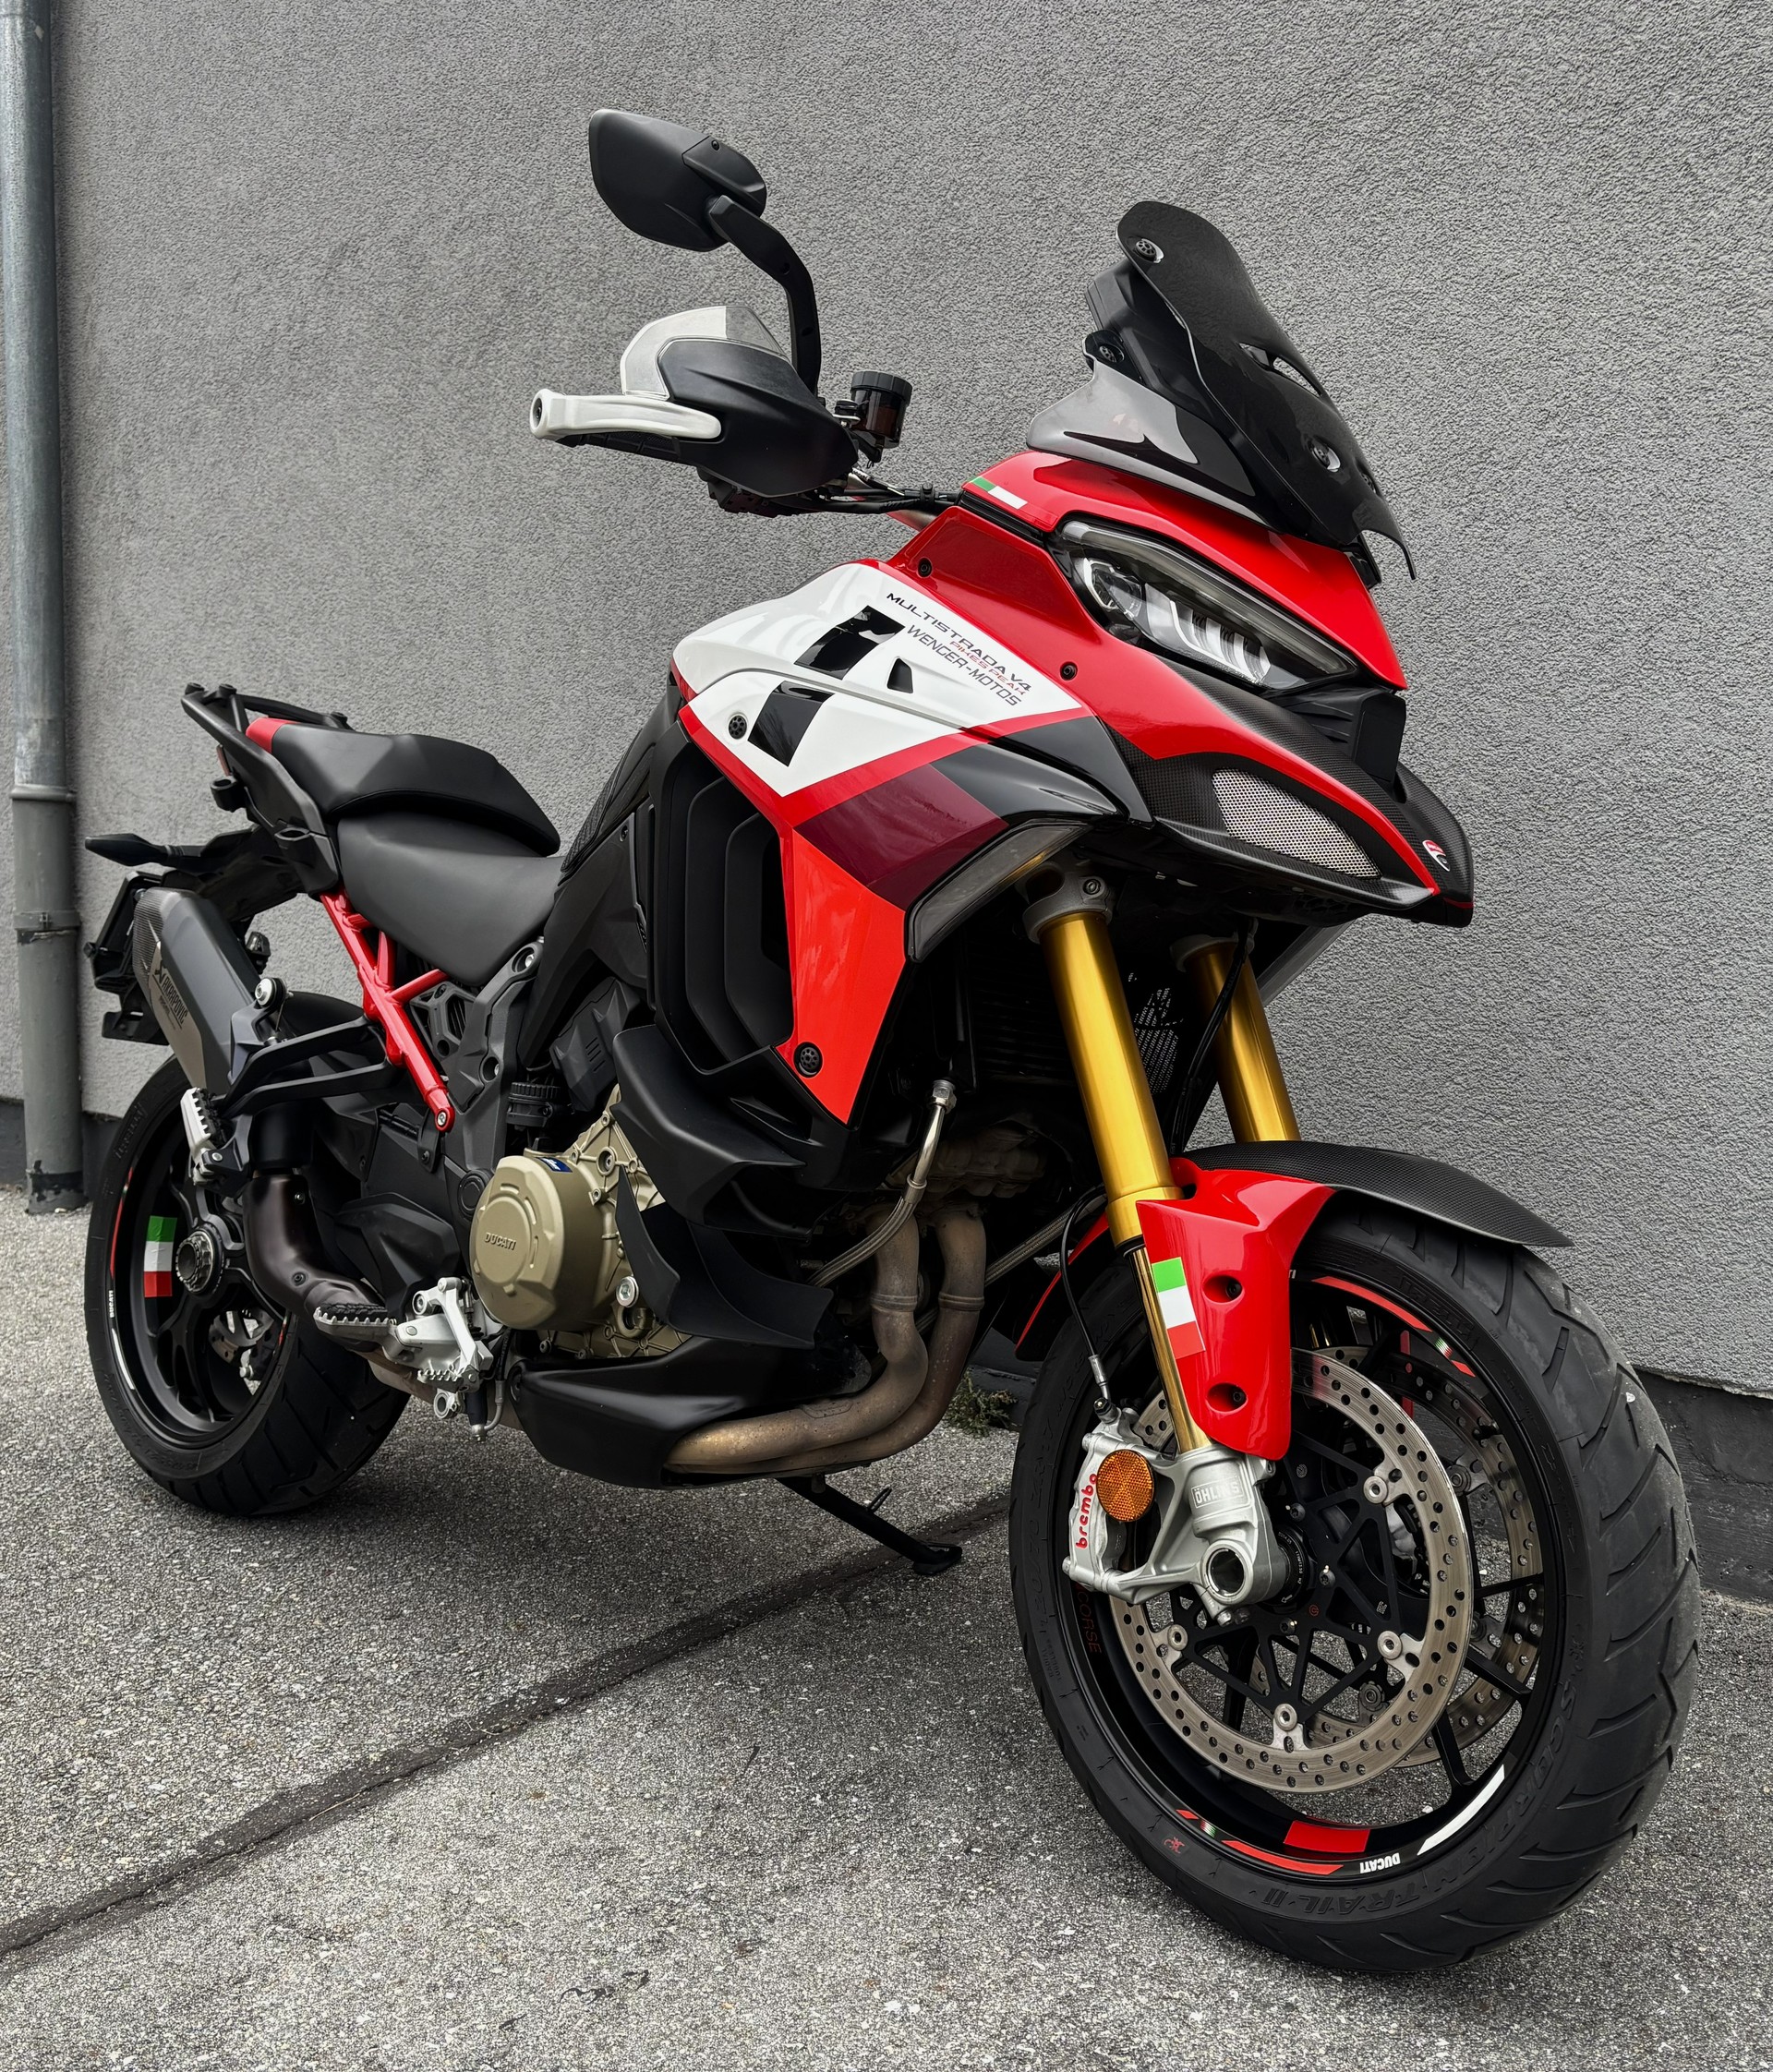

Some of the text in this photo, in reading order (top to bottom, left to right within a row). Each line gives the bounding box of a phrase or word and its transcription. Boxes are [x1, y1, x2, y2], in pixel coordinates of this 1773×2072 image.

[886, 593, 1031, 692] MULTISTRADA V4
[907, 624, 1021, 705] WENGER-MOTOS
[949, 641, 1026, 695] PIKES PEAK
[484, 1232, 516, 1251] DUCATI
[1075, 1473, 1098, 1549] brembo
[1077, 1591, 1103, 1654] CORSE
[1423, 1680, 1577, 1892] SCORPION
[1359, 1852, 1401, 1874] DUCATI
[1297, 1882, 1420, 1917] TRAIL
